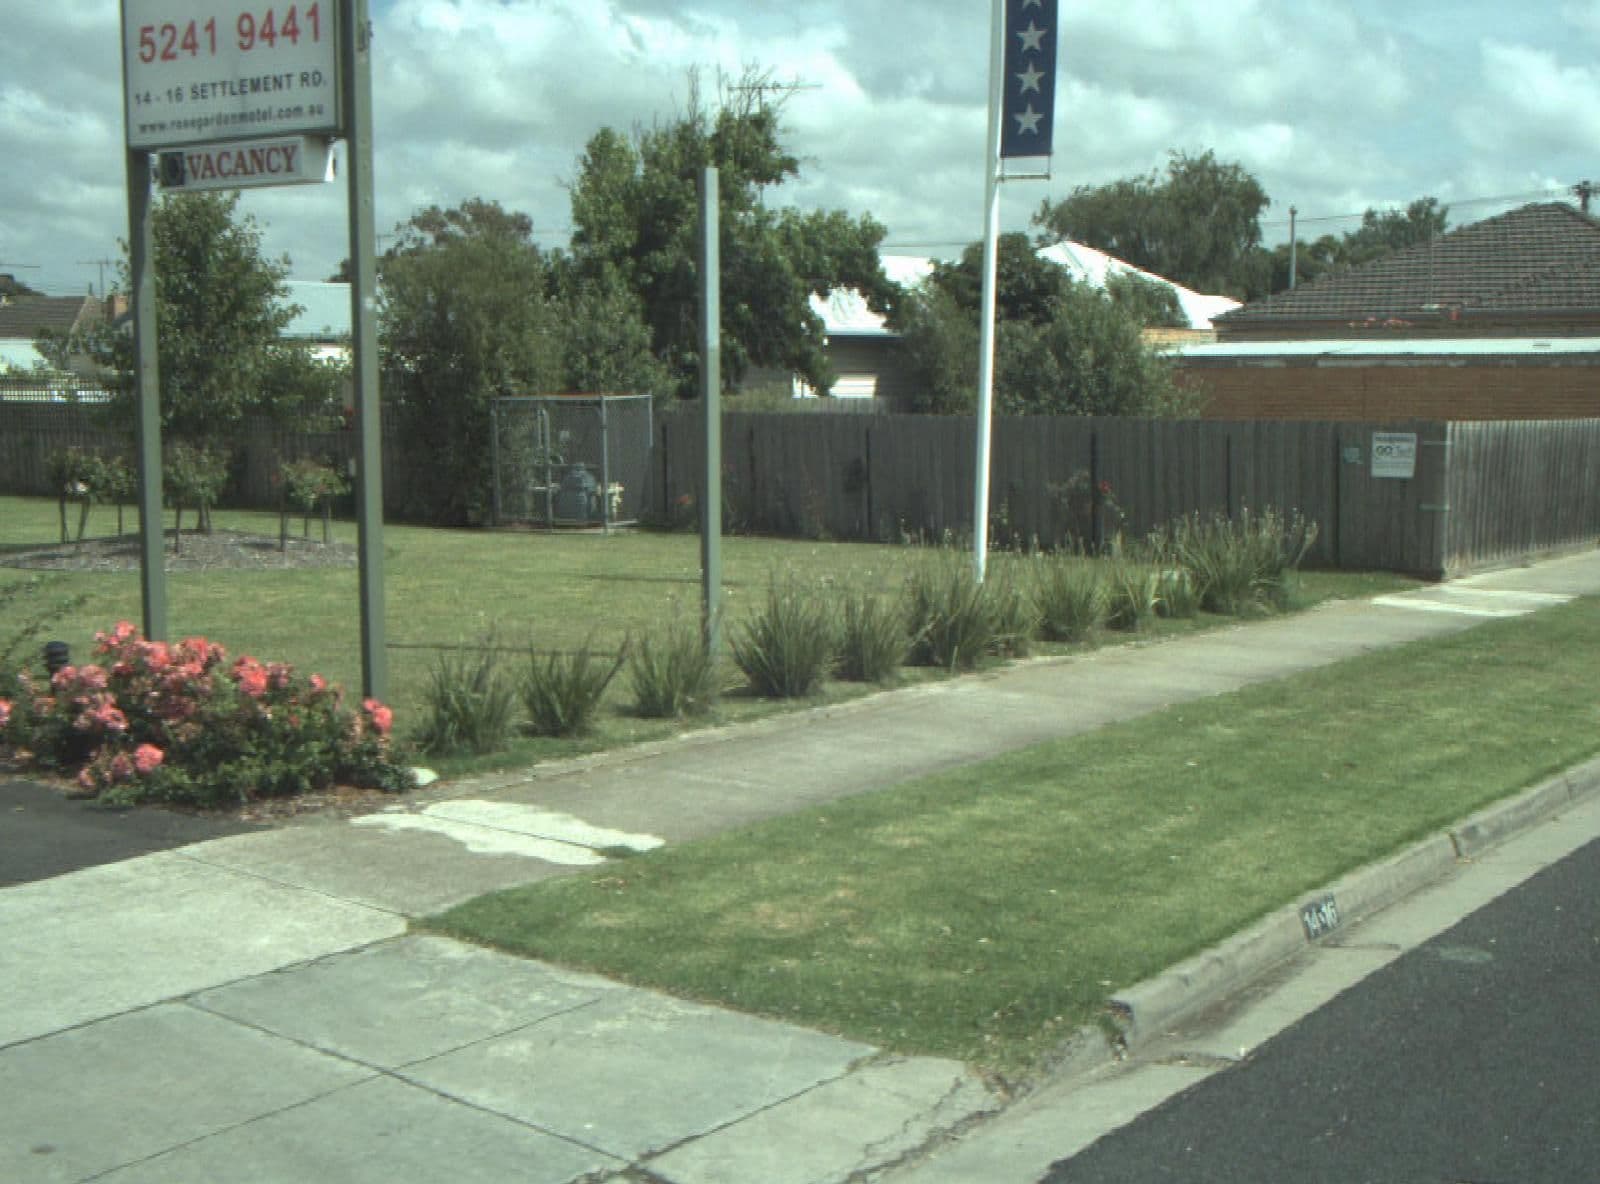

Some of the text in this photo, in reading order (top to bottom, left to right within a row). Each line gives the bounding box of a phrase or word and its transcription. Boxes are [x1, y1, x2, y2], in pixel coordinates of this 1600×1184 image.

[139, 2, 320, 63] 5241 9441
[135, 92, 150, 105] 14
[166, 87, 183, 104] 16
[190, 74, 294, 100] SETTLEMENT
[300, 70, 327, 88] RD.
[187, 144, 299, 180] VACANCY
